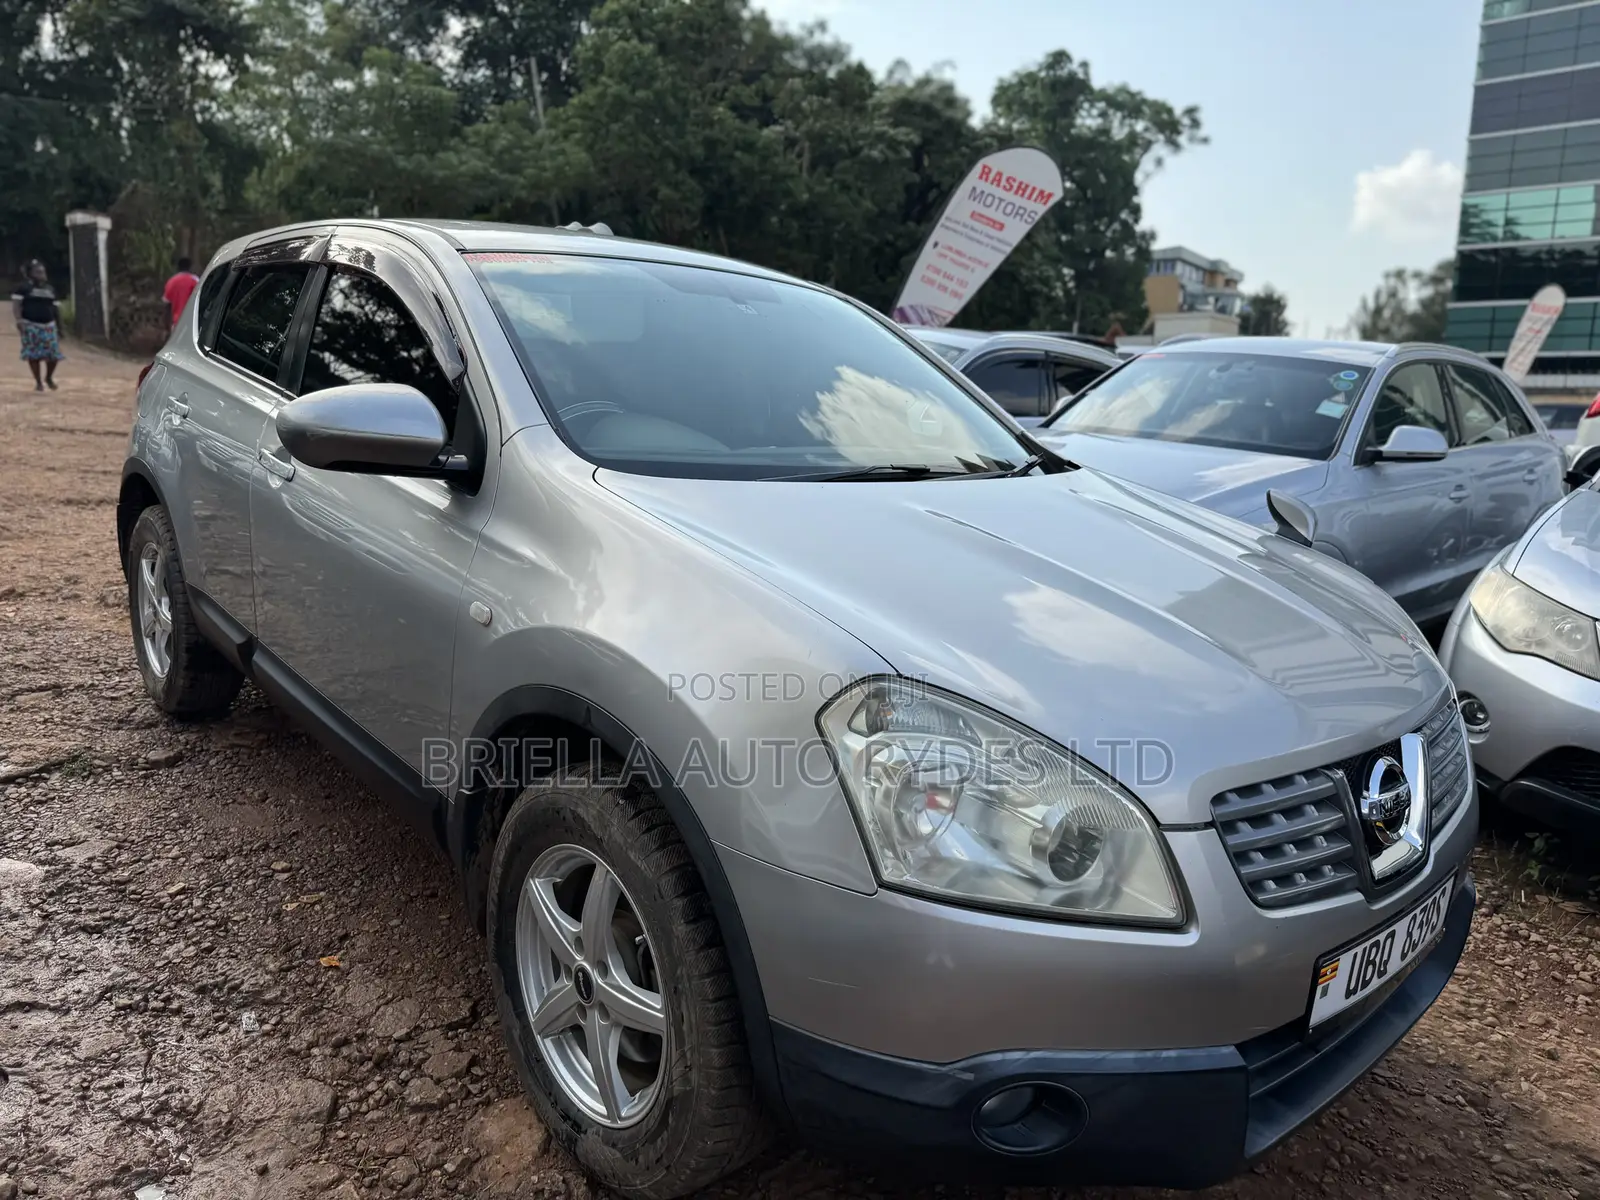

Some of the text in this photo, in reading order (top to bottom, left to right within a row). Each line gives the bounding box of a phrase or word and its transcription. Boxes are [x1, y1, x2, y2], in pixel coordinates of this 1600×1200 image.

[968, 186, 1038, 225] MOTORS
[978, 163, 1054, 206] RASHIM
[1345, 886, 1447, 999] UBQ 839S
